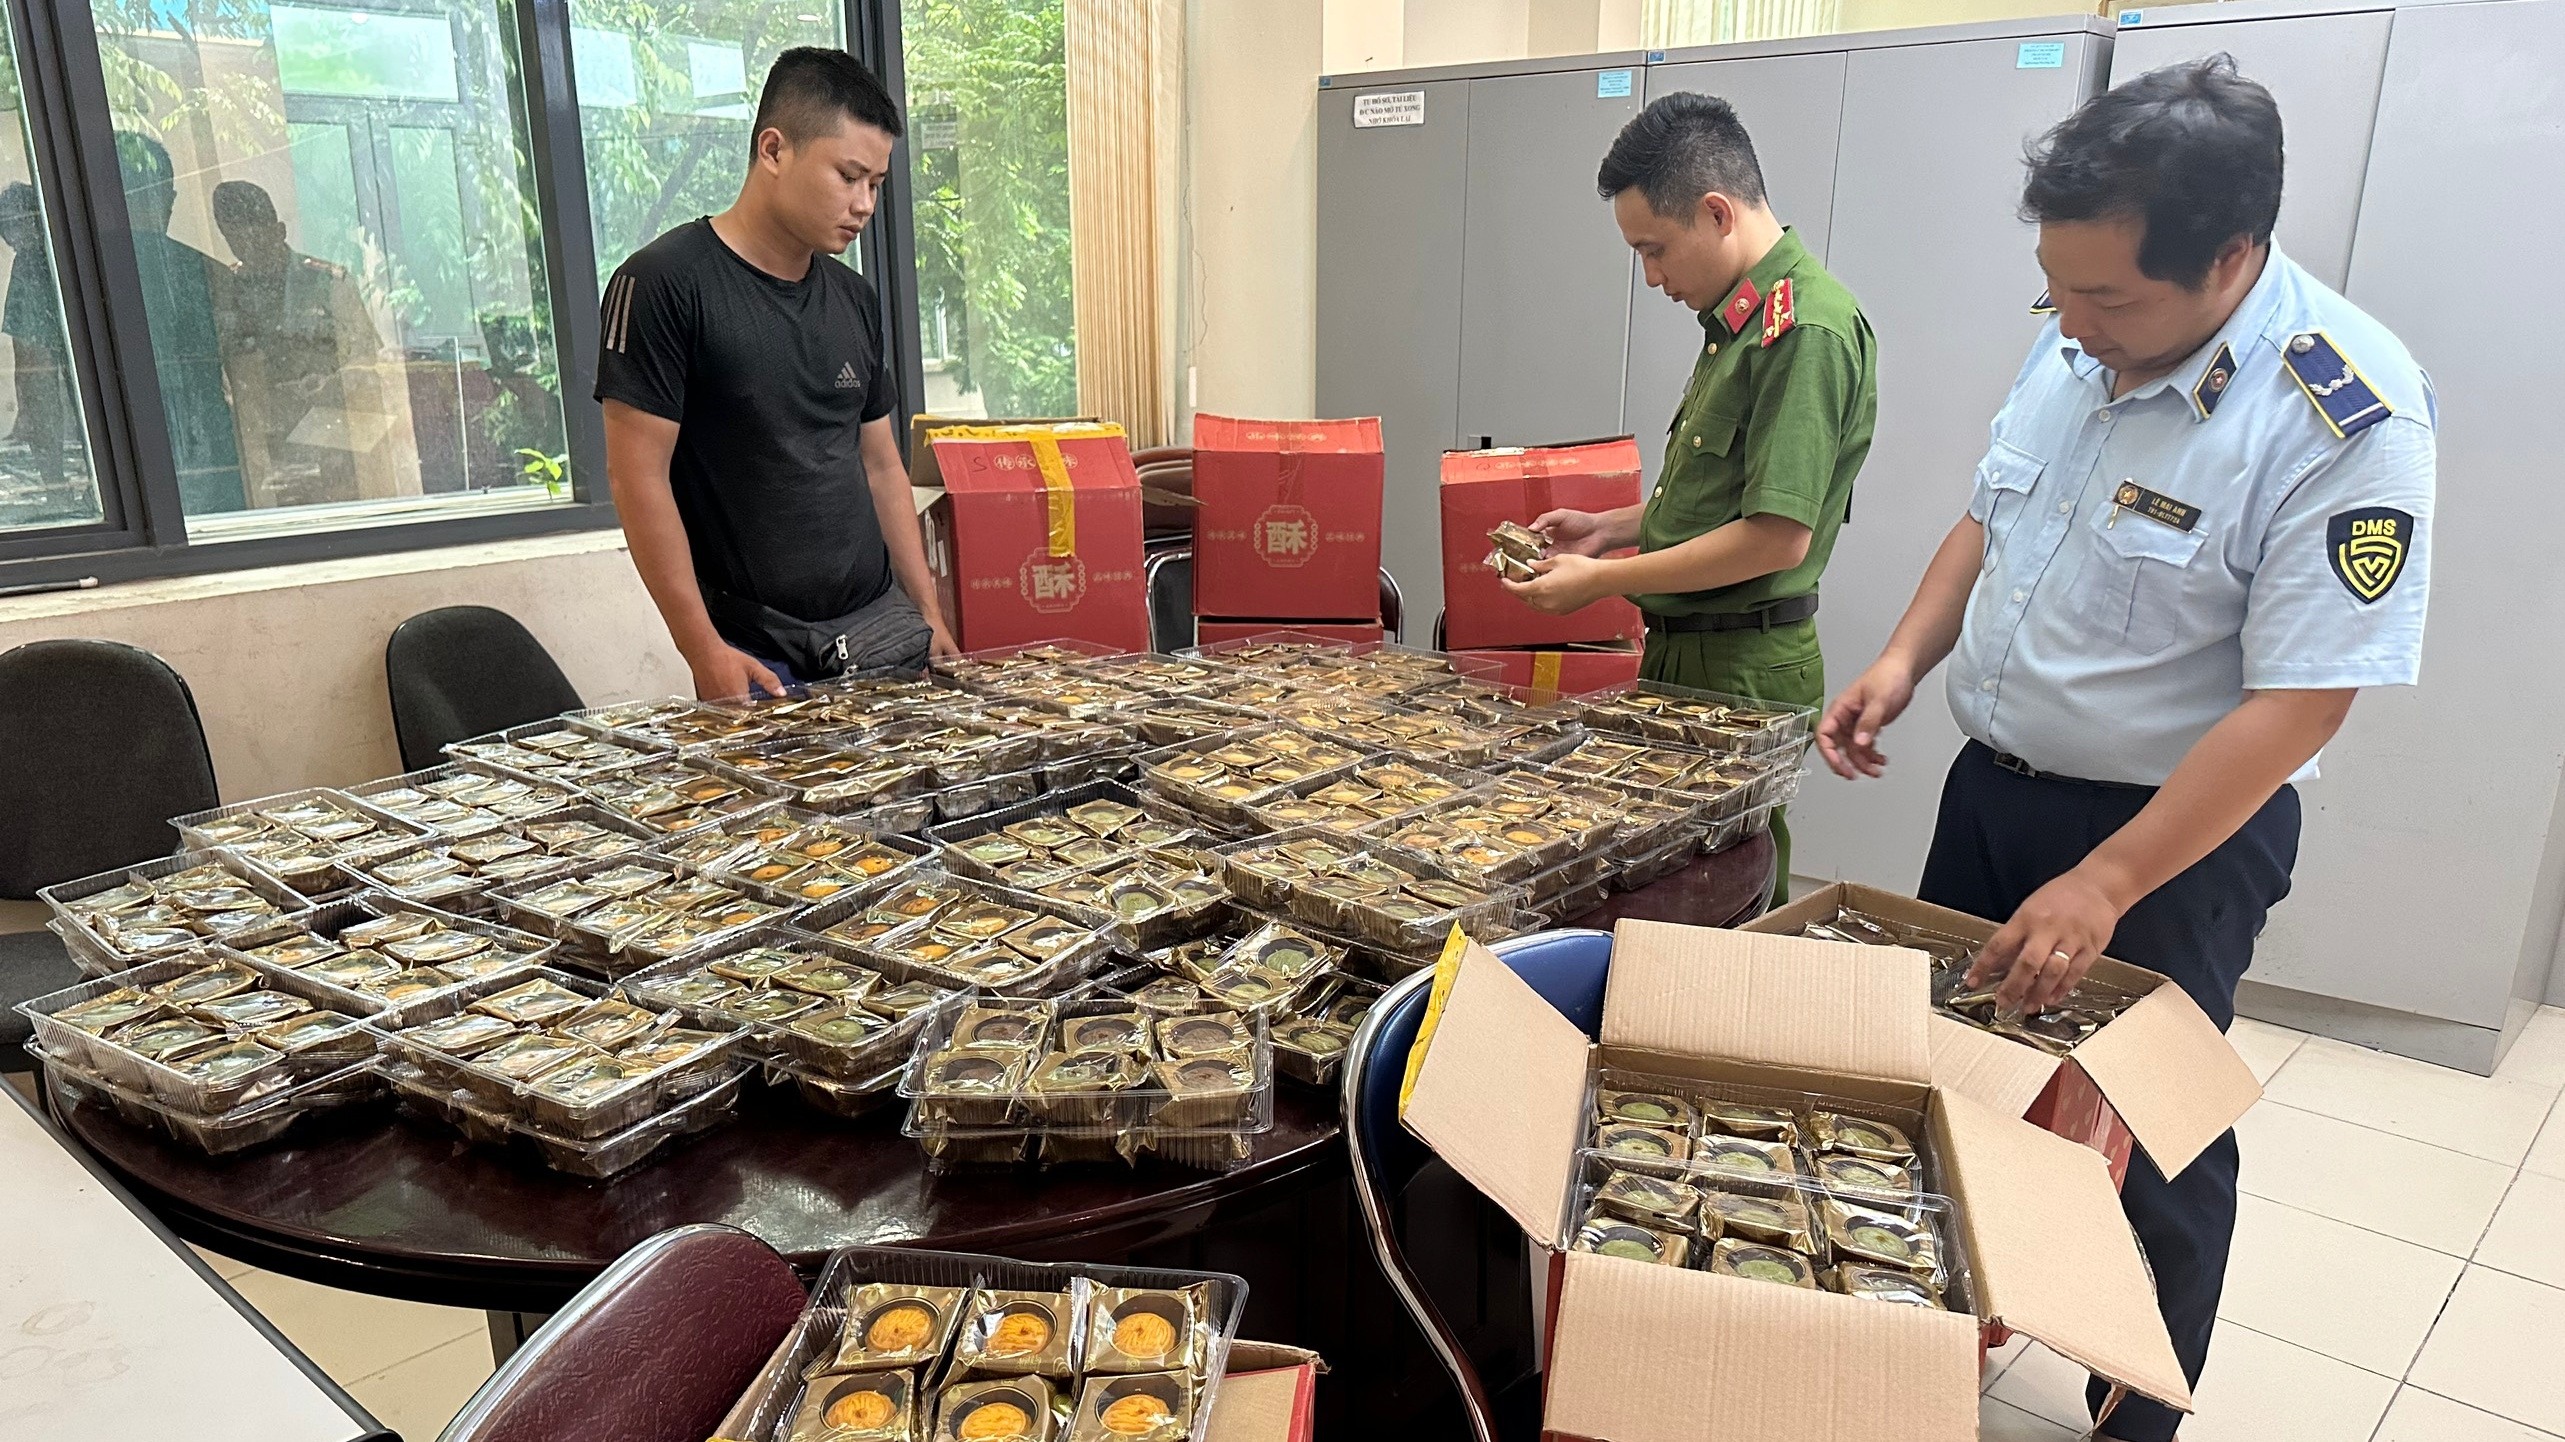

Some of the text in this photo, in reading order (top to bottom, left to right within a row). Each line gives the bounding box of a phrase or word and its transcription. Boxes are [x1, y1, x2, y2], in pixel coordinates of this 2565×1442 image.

[835, 378, 860, 388] adidas
[1266, 519, 1308, 555] 酥
[2352, 519, 2397, 536] DMS
[1032, 561, 1076, 599] 酥
